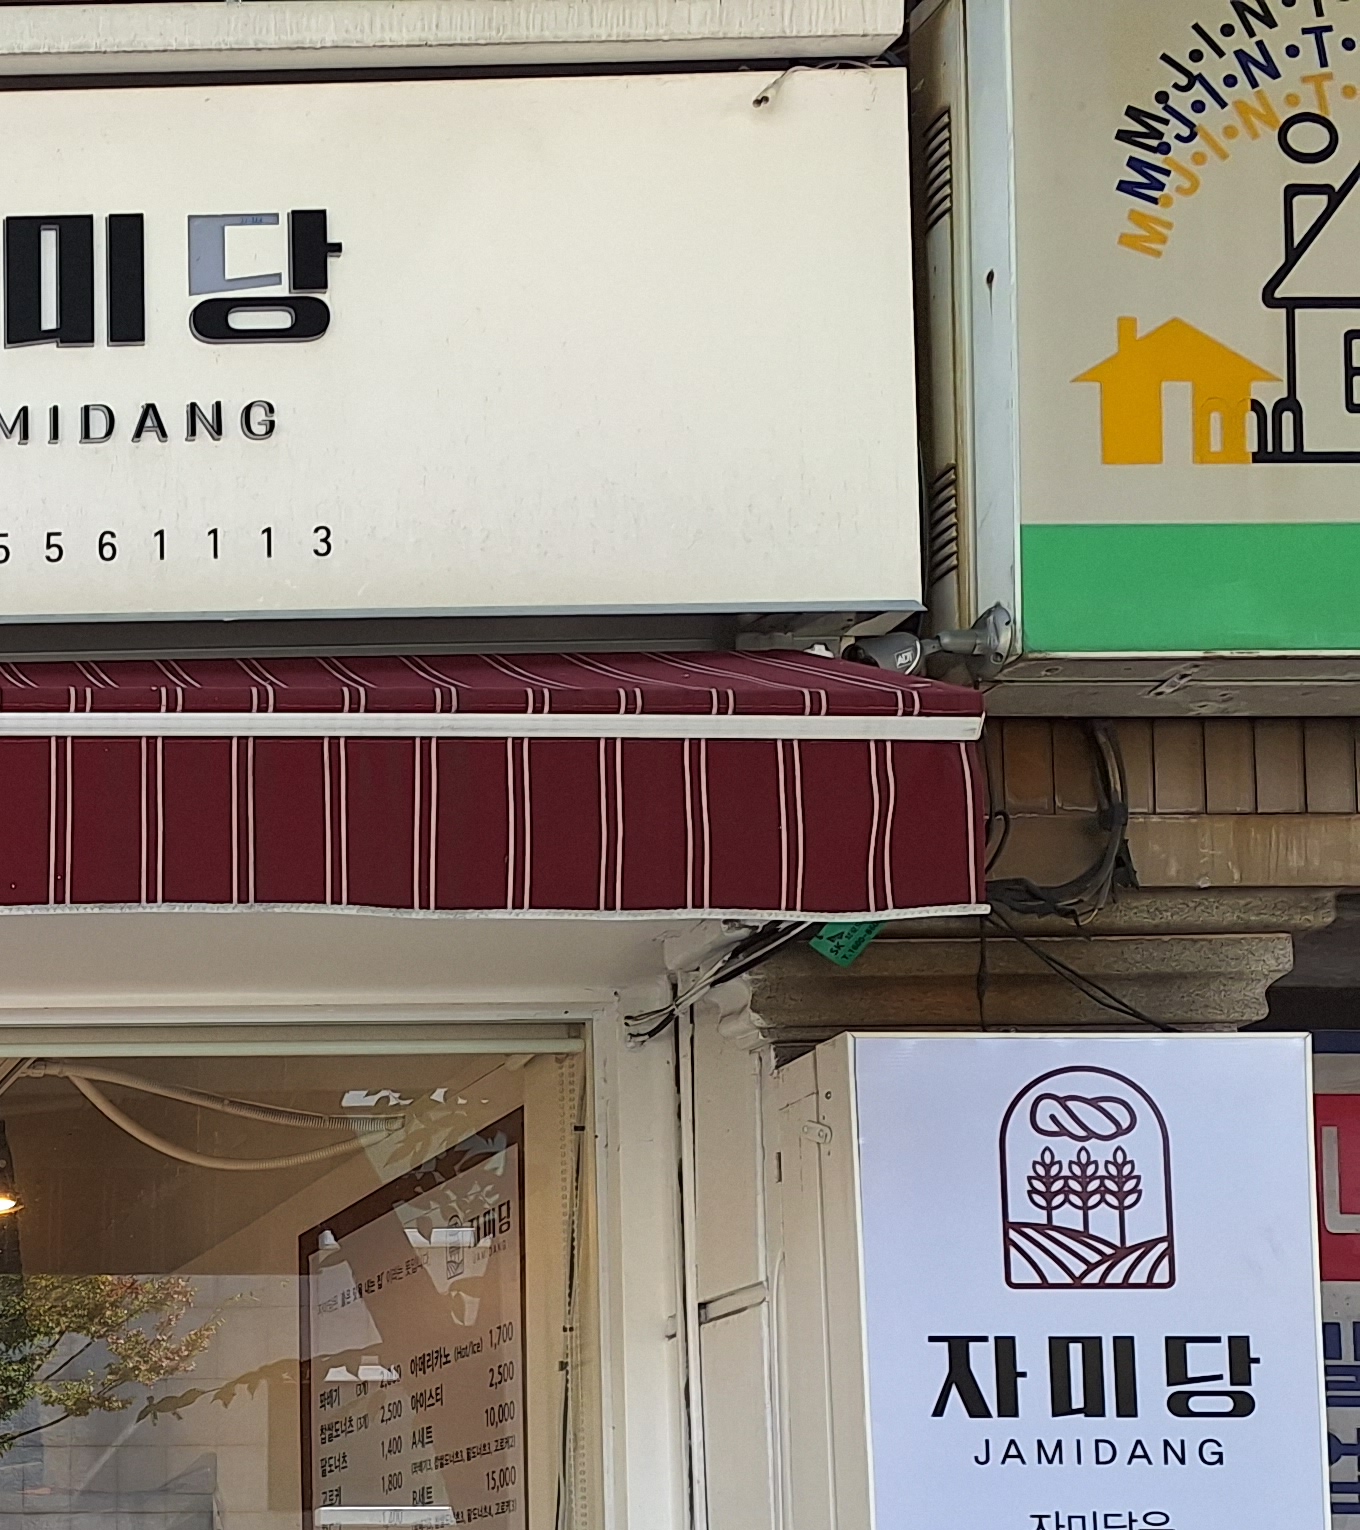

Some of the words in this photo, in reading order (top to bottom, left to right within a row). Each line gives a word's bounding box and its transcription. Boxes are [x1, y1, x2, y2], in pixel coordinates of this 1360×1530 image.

[410, 1346, 451, 1378] 아메리카노
[488, 1321, 513, 1350] 1,700
[410, 1383, 443, 1414] 아이스티
[488, 1361, 514, 1390] 2,500
[928, 1335, 1261, 1418] 자미당
[320, 1415, 354, 1445] 찹쌀도너츠
[380, 1400, 402, 1425] 2,500
[485, 1401, 515, 1428] 10,000
[320, 1452, 348, 1478] 팥도너츠
[381, 1435, 402, 1461] 1,400
[974, 1438, 1225, 1466] JAMIDANG
[382, 1471, 403, 1496] 1,800
[486, 1465, 516, 1493] 15,000
